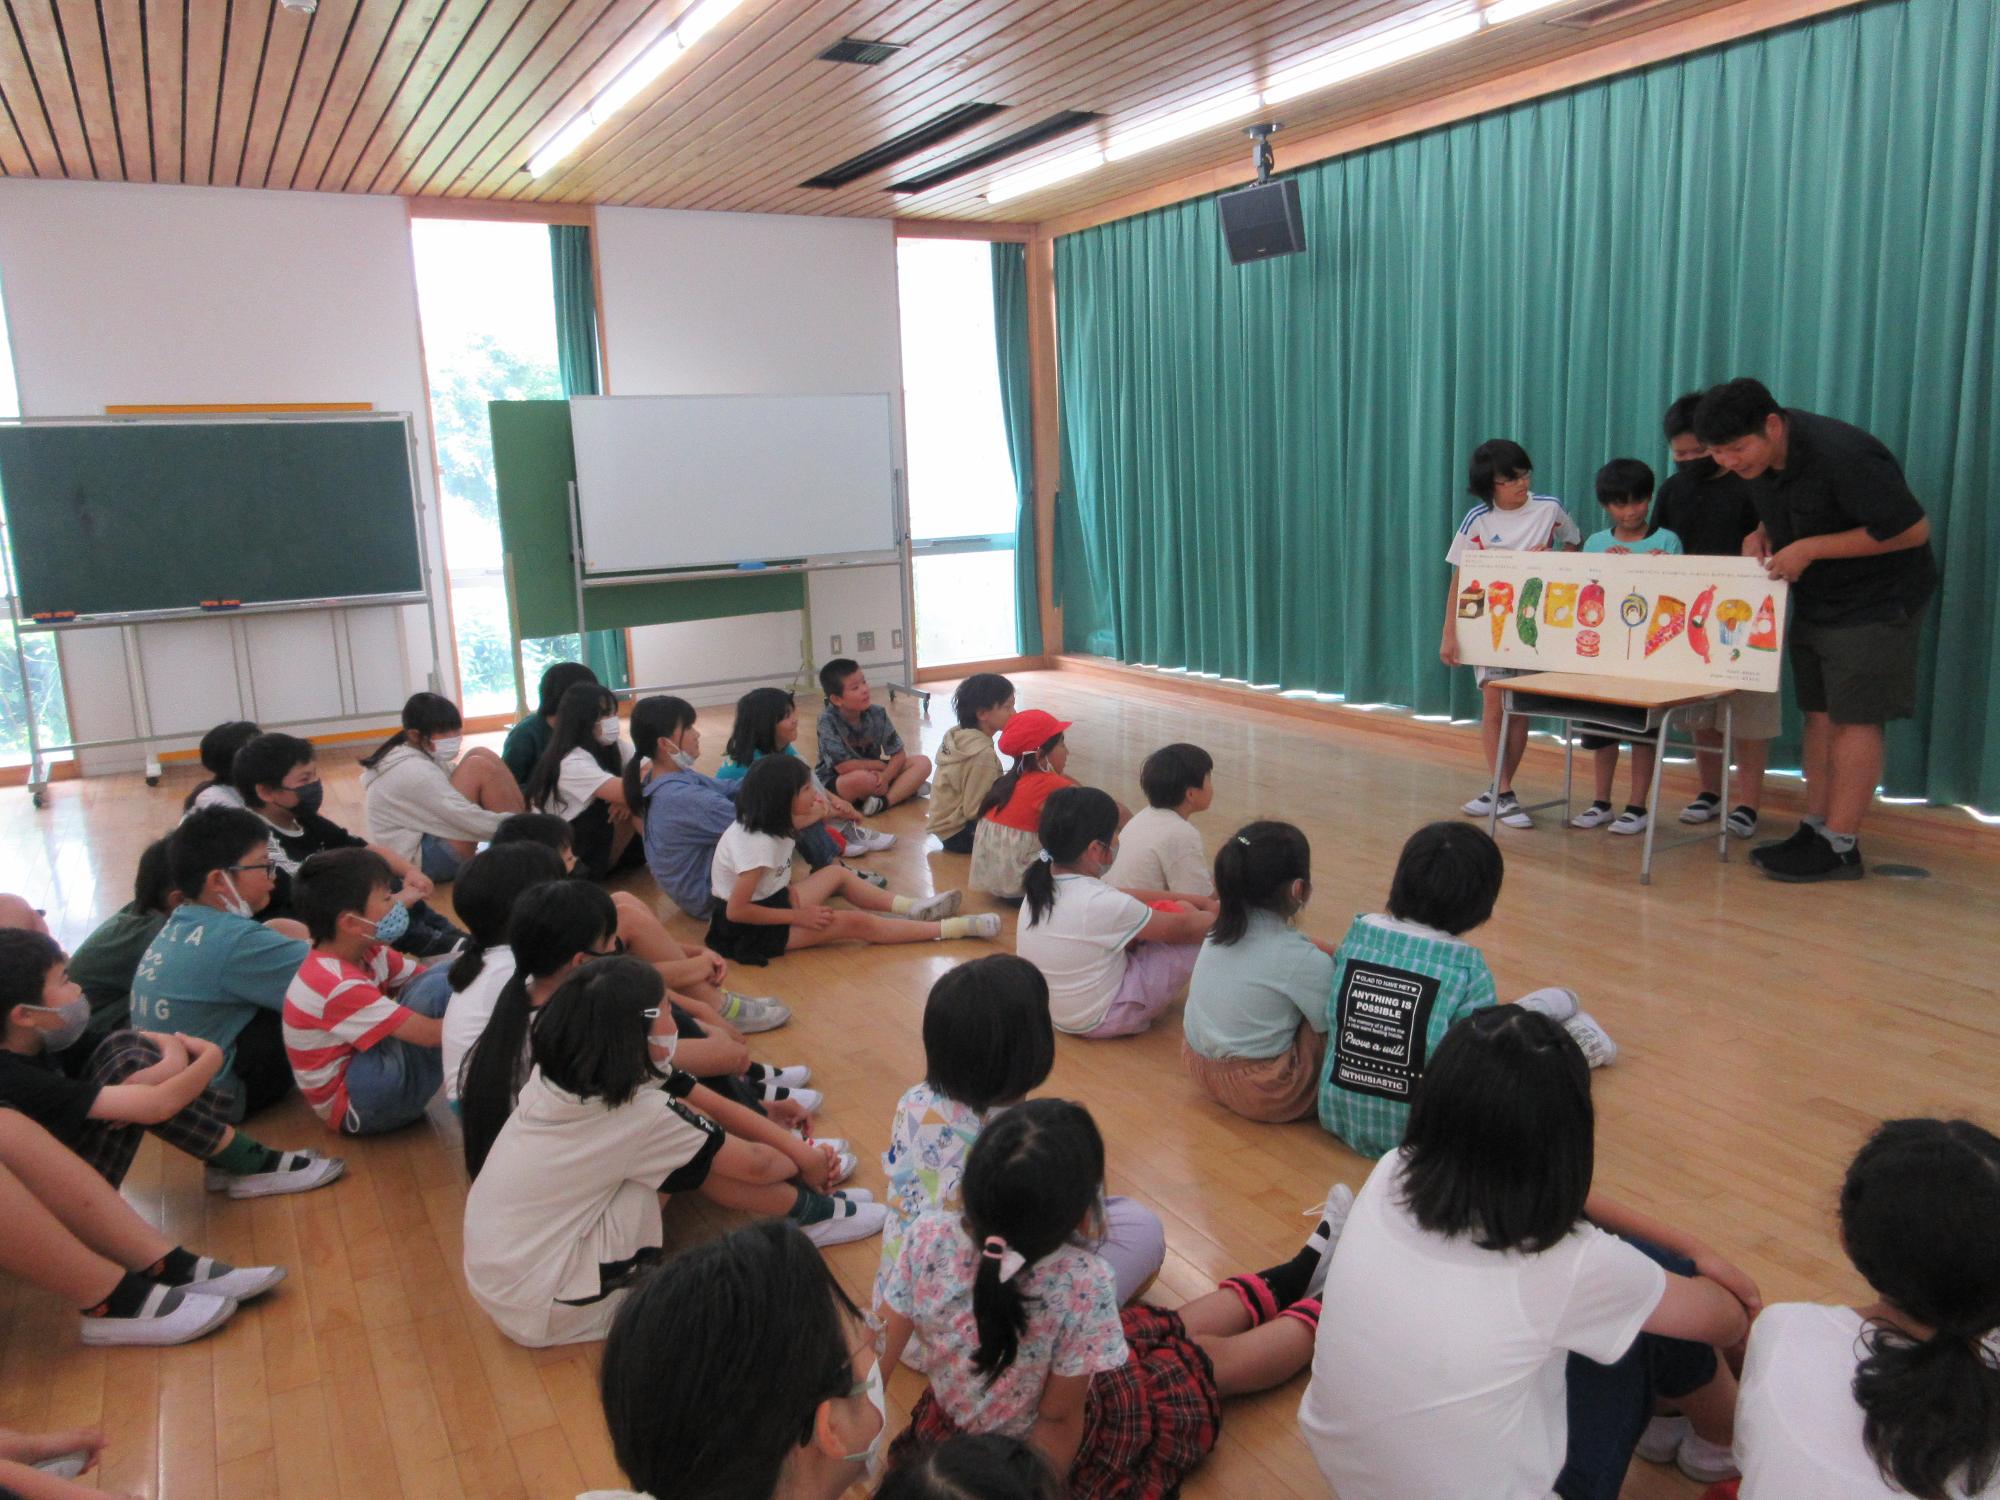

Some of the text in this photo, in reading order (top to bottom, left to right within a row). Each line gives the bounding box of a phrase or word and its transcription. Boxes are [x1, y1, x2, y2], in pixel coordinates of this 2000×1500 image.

[1360, 975, 1375, 984] GLAD
[1383, 980, 1398, 989] HAVE
[1399, 984, 1411, 992] MET
[1351, 989, 1412, 1010] ANYTHING IS
[1356, 1001, 1402, 1019] POSSIBLE
[1345, 1031, 1405, 1056] Prove a will
